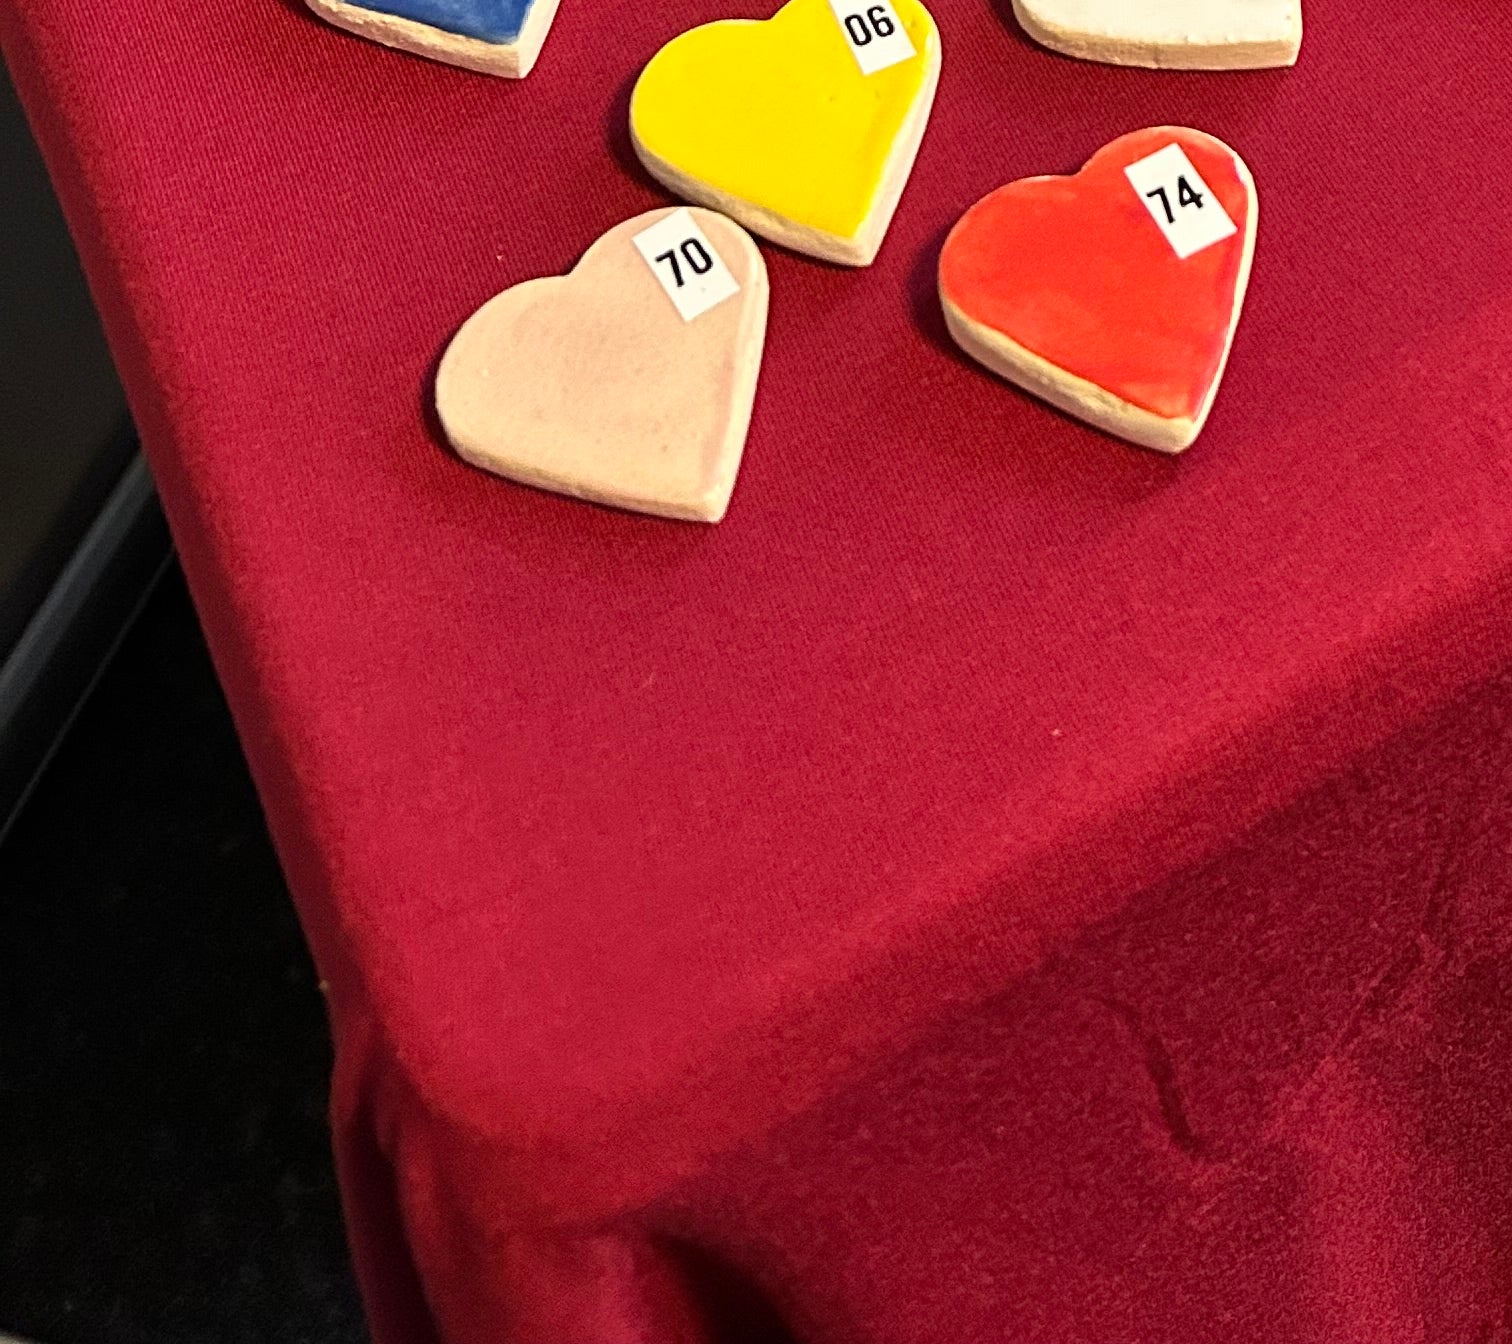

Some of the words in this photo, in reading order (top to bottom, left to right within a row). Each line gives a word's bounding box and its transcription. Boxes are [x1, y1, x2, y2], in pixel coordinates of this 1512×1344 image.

[845, 6, 894, 46] 06
[1145, 176, 1207, 226] 74
[656, 239, 713, 287] 70
